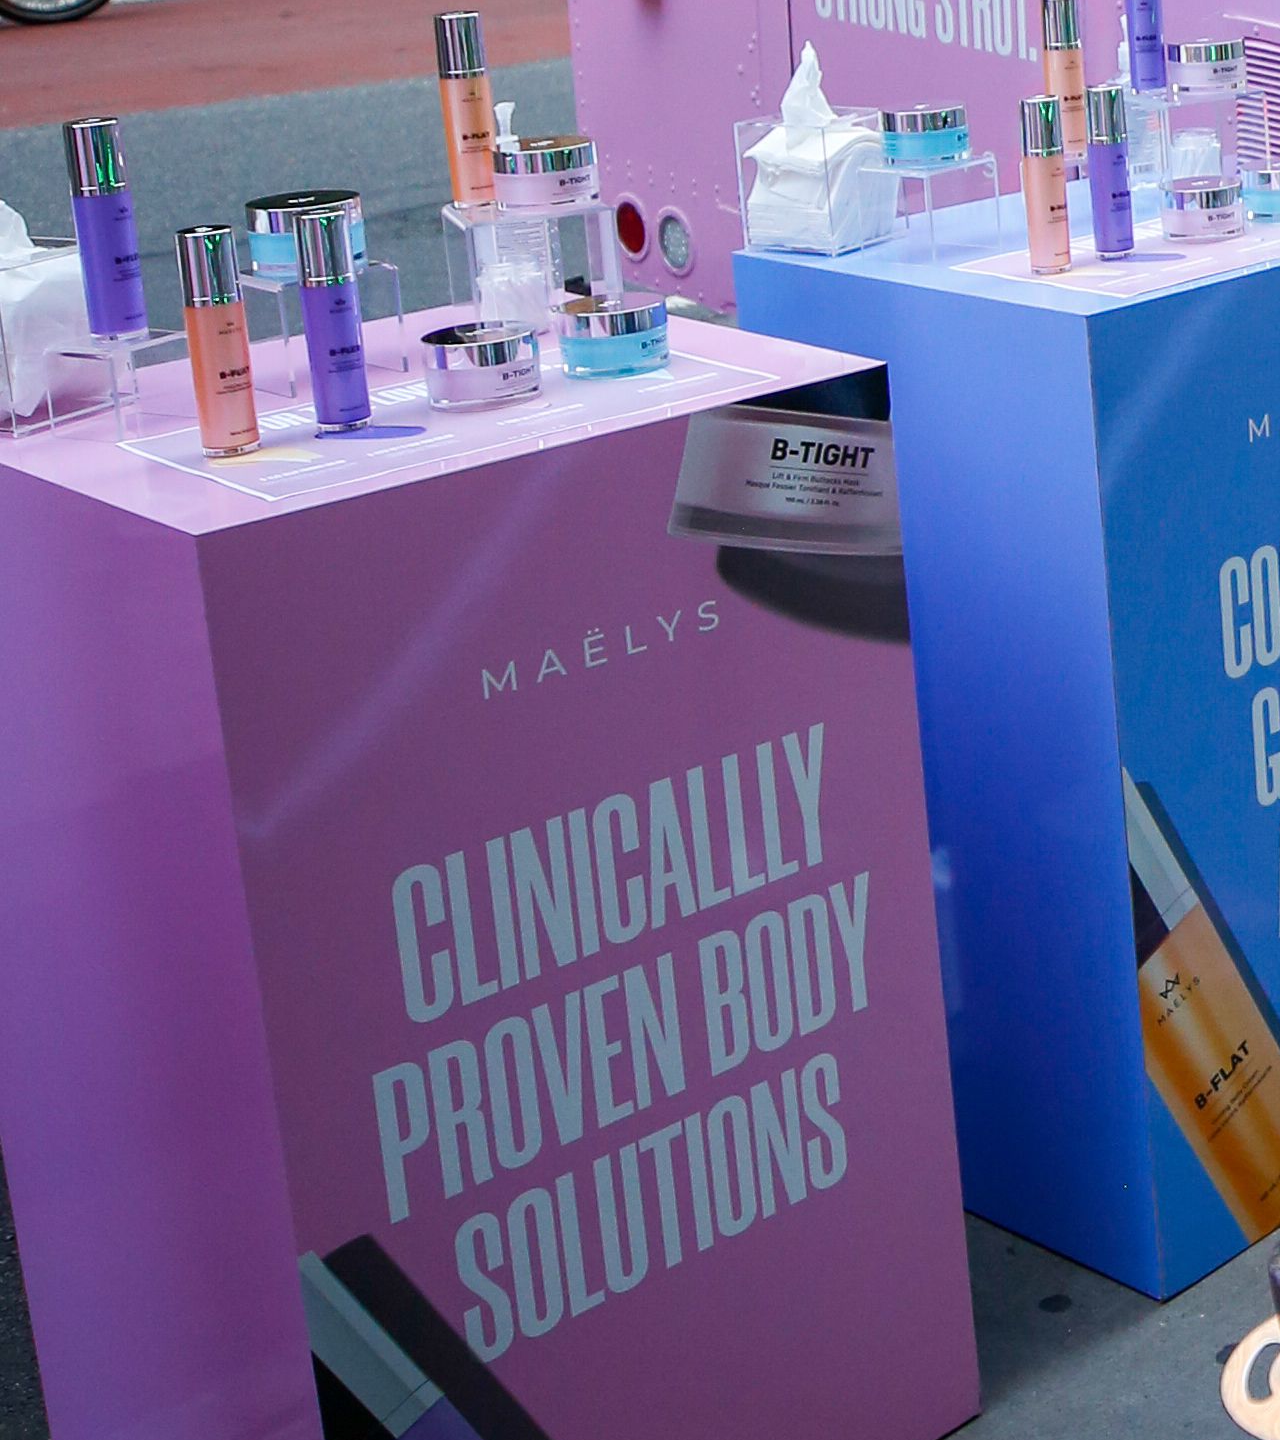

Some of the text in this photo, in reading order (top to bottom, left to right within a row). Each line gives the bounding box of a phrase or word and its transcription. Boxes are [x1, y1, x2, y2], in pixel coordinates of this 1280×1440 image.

[502, 365, 536, 382] B-TIGHT
[770, 438, 876, 469] B-TIGHT
[480, 600, 721, 701] MAËLYS
[391, 721, 825, 1024] CLINICALLY
[371, 870, 871, 1226] PROVEN BODY
[1194, 1039, 1250, 1110] B-FLAT
[453, 1052, 849, 1363] SOLUTIONS
